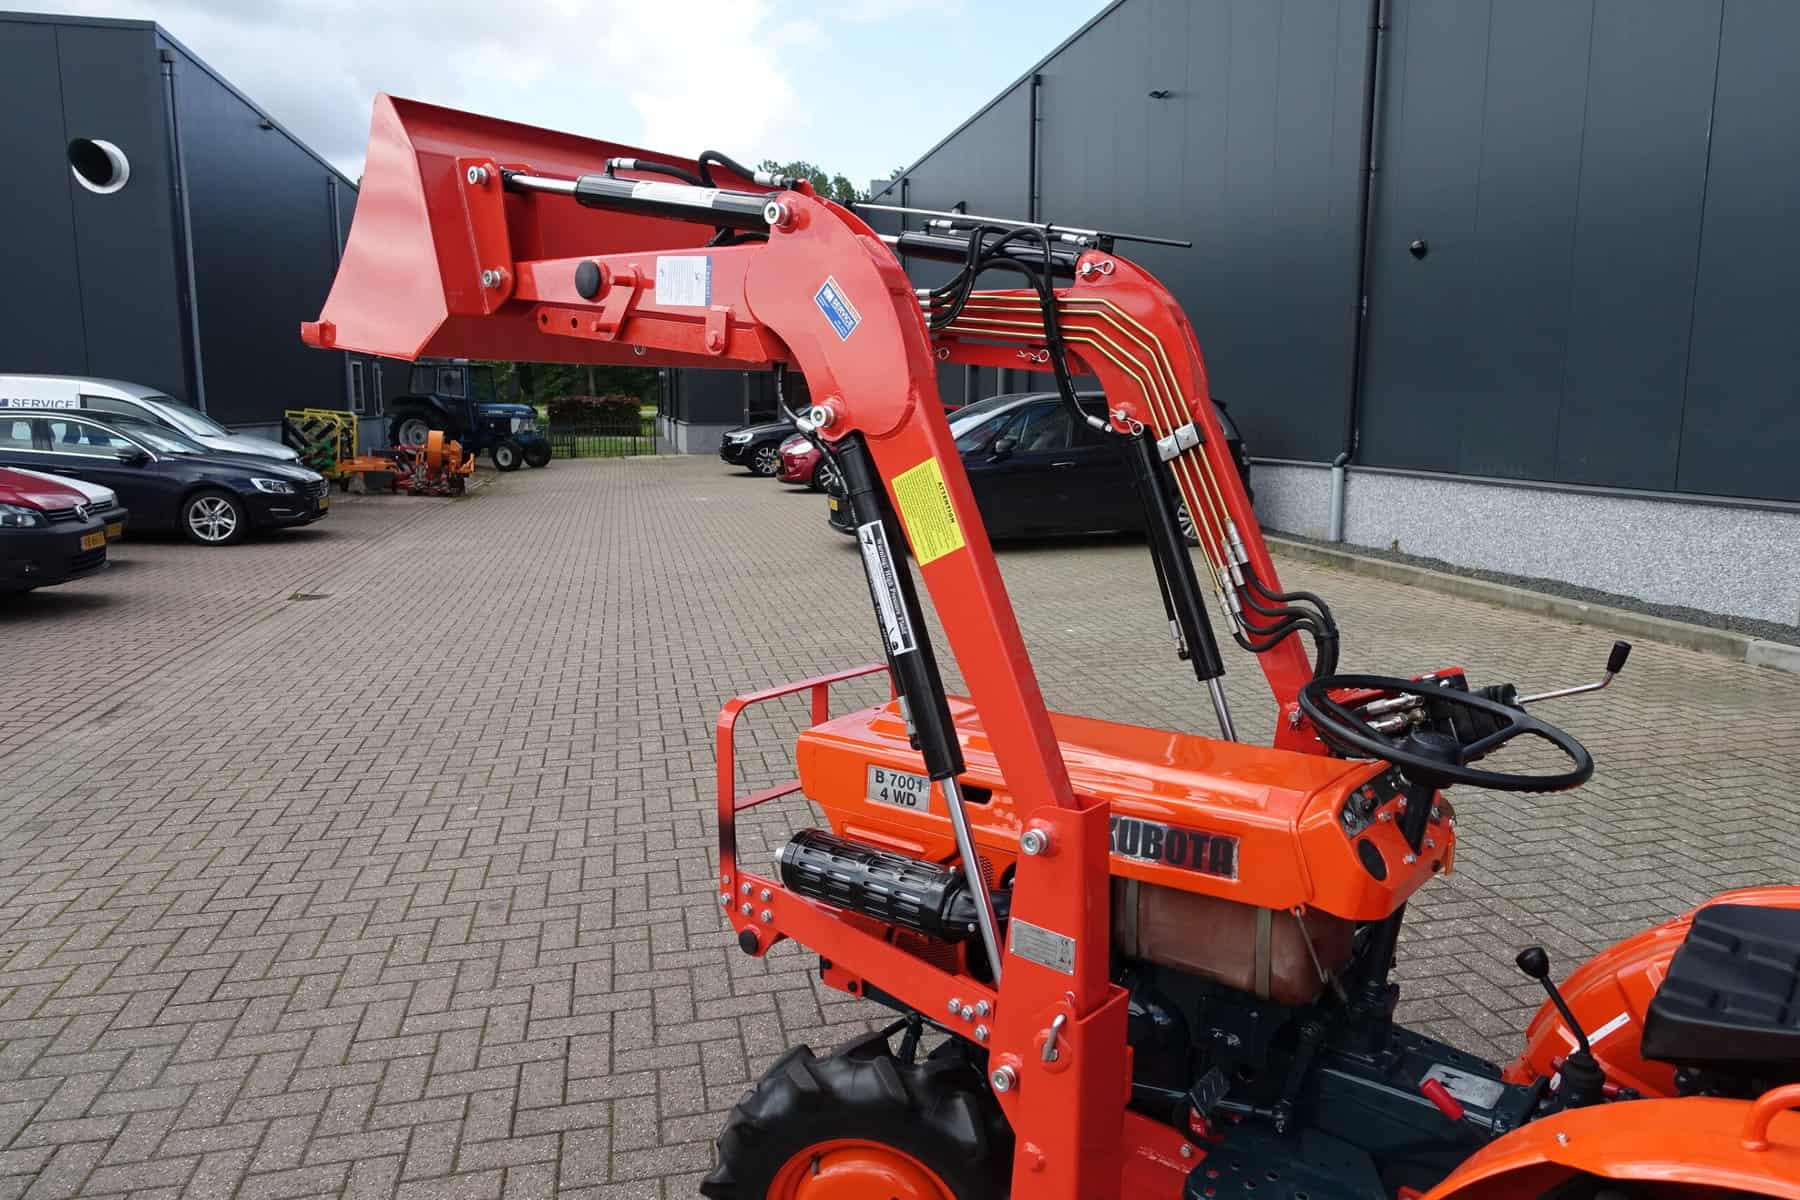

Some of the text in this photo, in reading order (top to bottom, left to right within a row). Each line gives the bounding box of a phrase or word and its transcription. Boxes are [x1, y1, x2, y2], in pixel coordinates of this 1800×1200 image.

[11, 398, 74, 408] SERVICE
[937, 481, 955, 523] ATTENTION
[876, 769, 923, 792] B 7001
[880, 787, 916, 806] 4 WD
